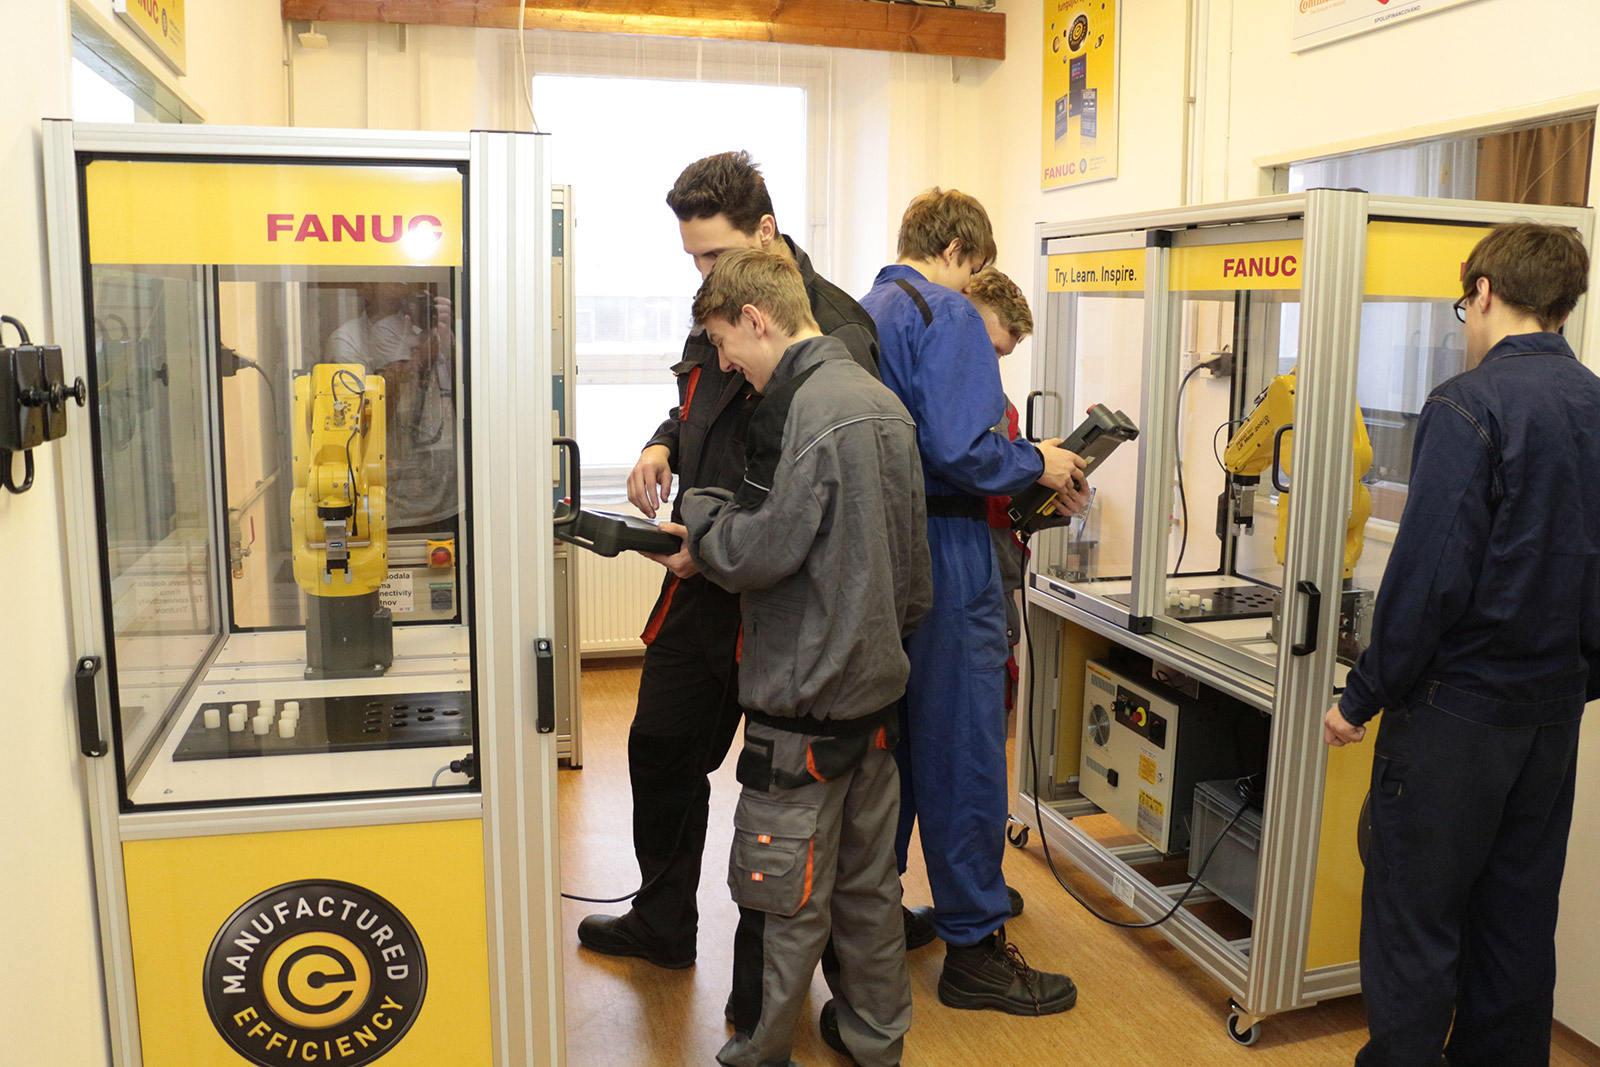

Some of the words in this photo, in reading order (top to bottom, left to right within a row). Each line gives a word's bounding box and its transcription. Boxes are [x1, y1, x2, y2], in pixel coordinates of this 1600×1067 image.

[1044, 162, 1076, 180] FANUC
[267, 214, 443, 243] FANUC
[1055, 268, 1068, 287] Try.
[1071, 267, 1098, 282] Learn.
[1101, 265, 1137, 286] Inspire.
[1223, 255, 1297, 278] FANUC
[380, 590, 412, 598] nectivity
[222, 896, 409, 994] MANUFACTURED
[233, 995, 404, 1061] EFFICIENCY
